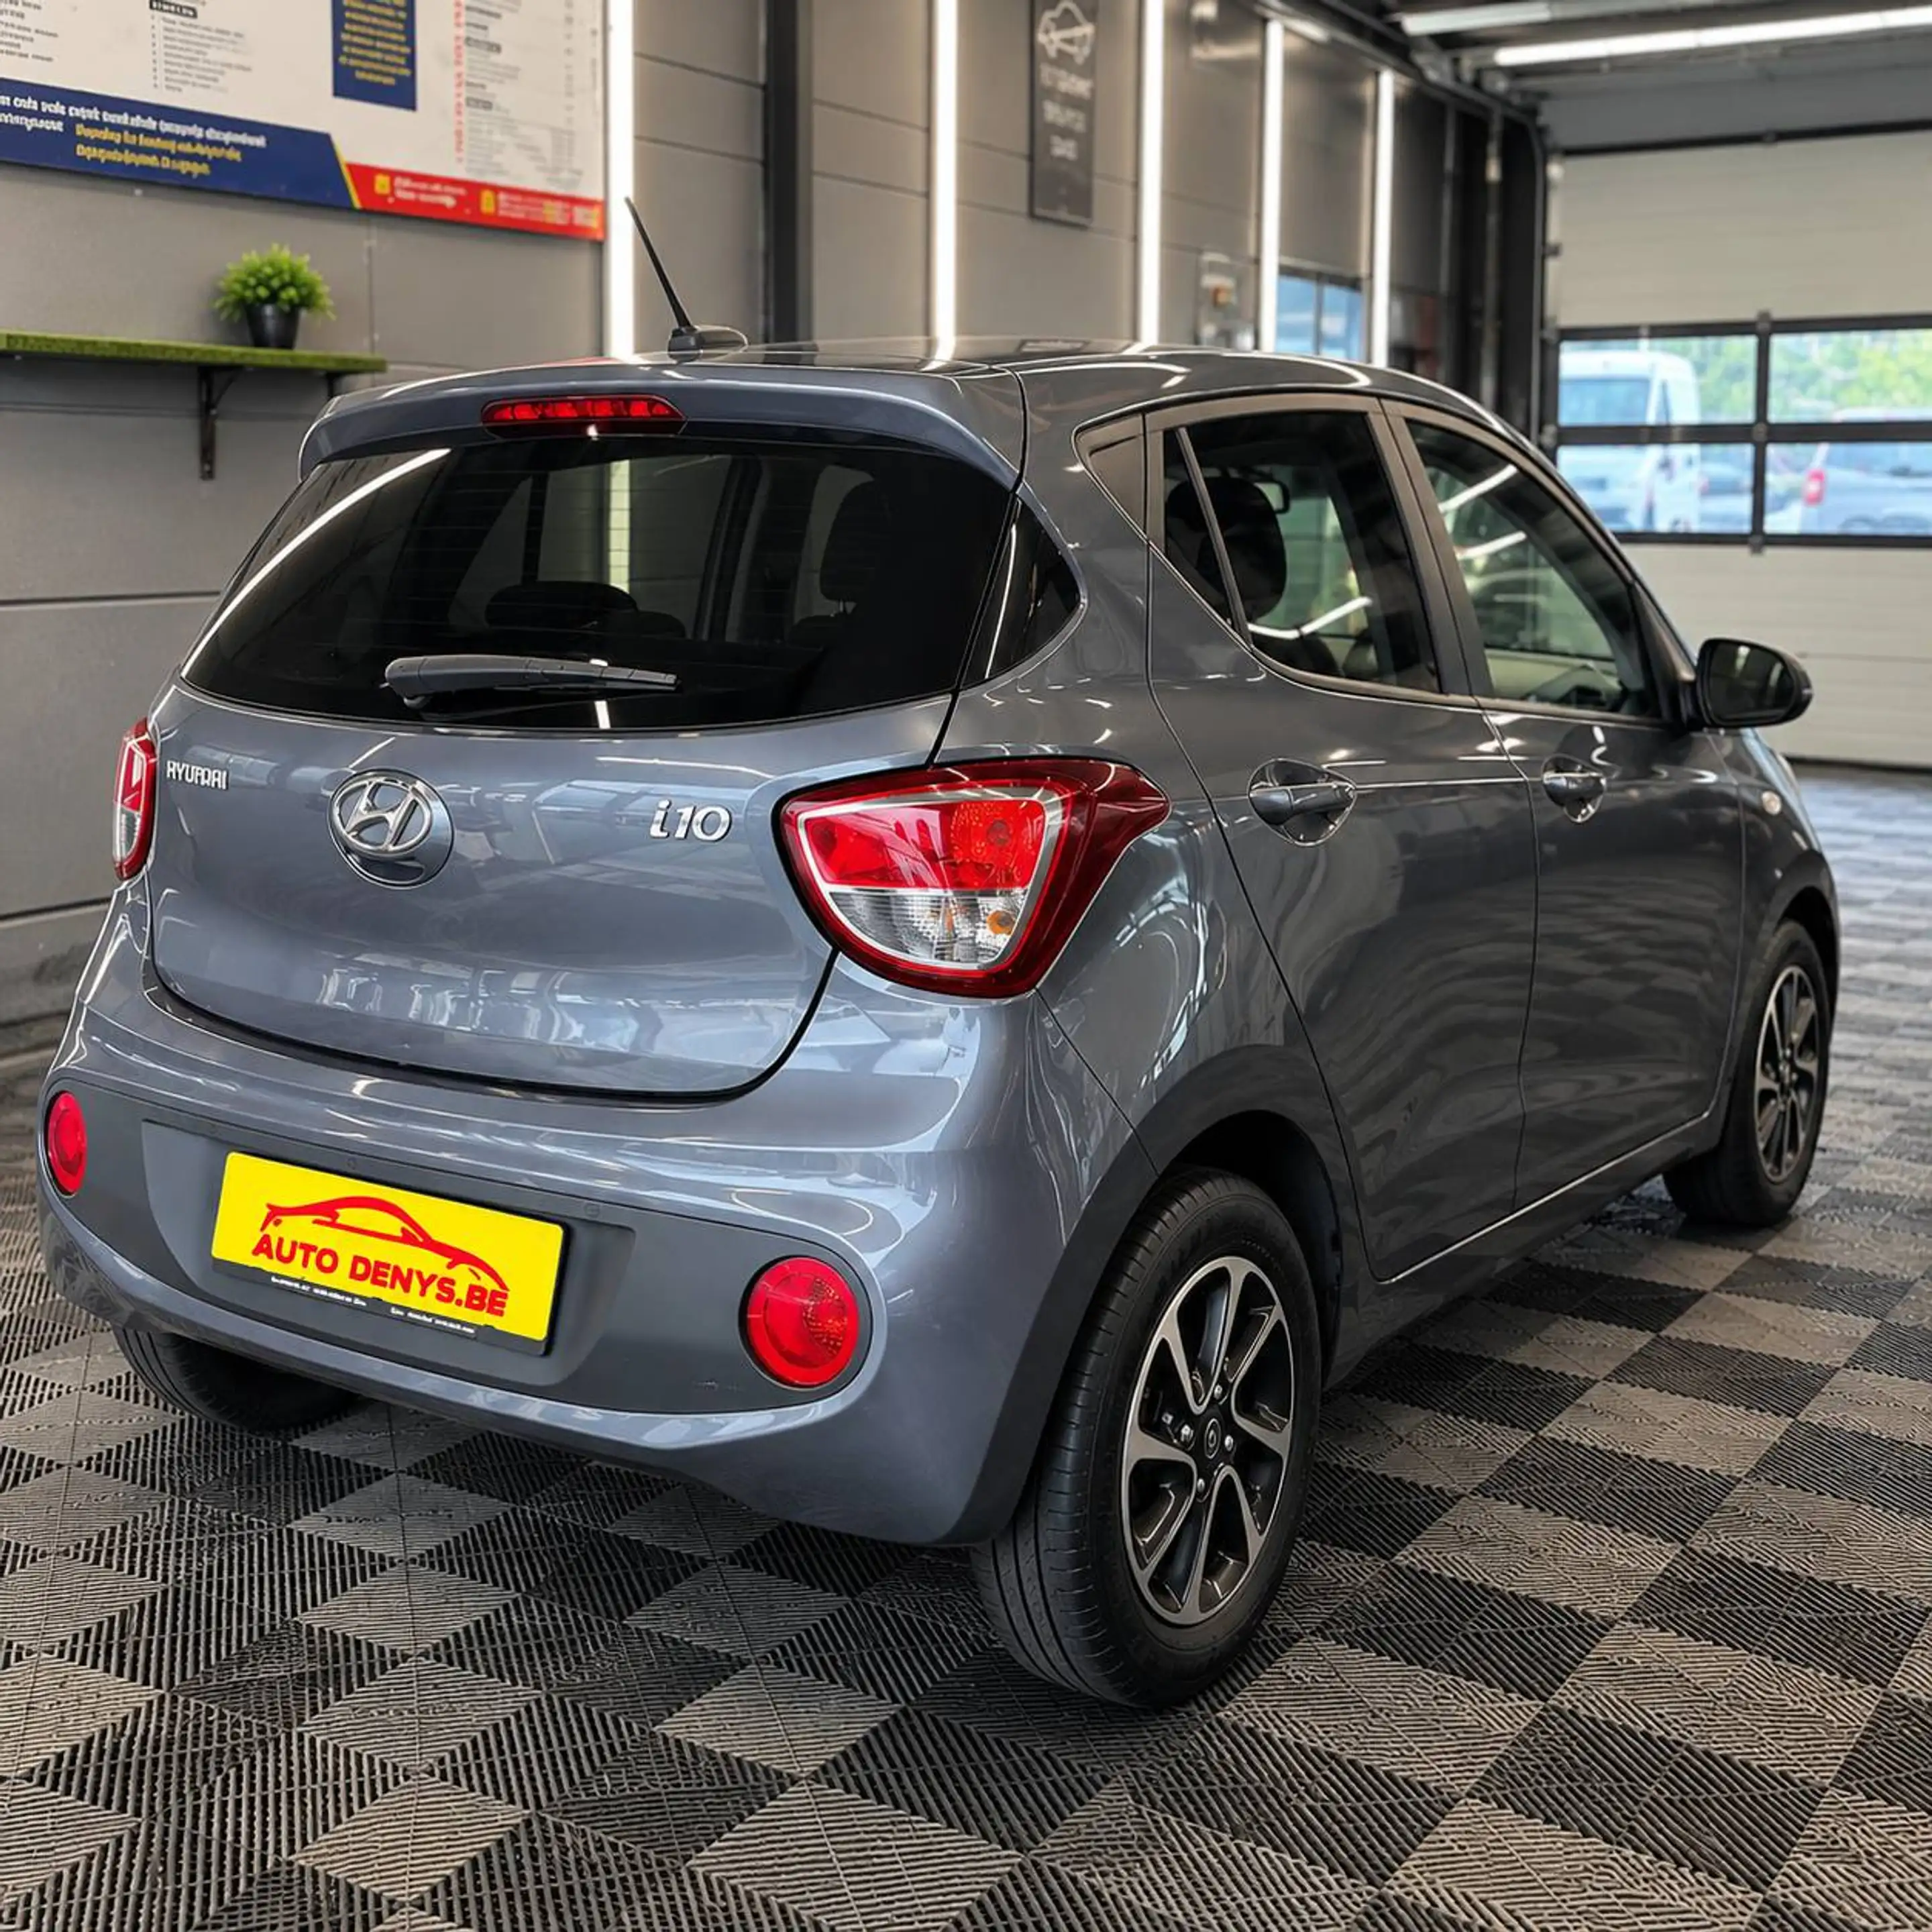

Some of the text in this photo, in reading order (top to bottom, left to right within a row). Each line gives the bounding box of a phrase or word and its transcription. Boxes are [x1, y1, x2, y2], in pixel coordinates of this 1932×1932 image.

[649, 799, 733, 842] i10
[252, 1233, 339, 1273] AUTO
[348, 1255, 509, 1317] DENYS.BE
